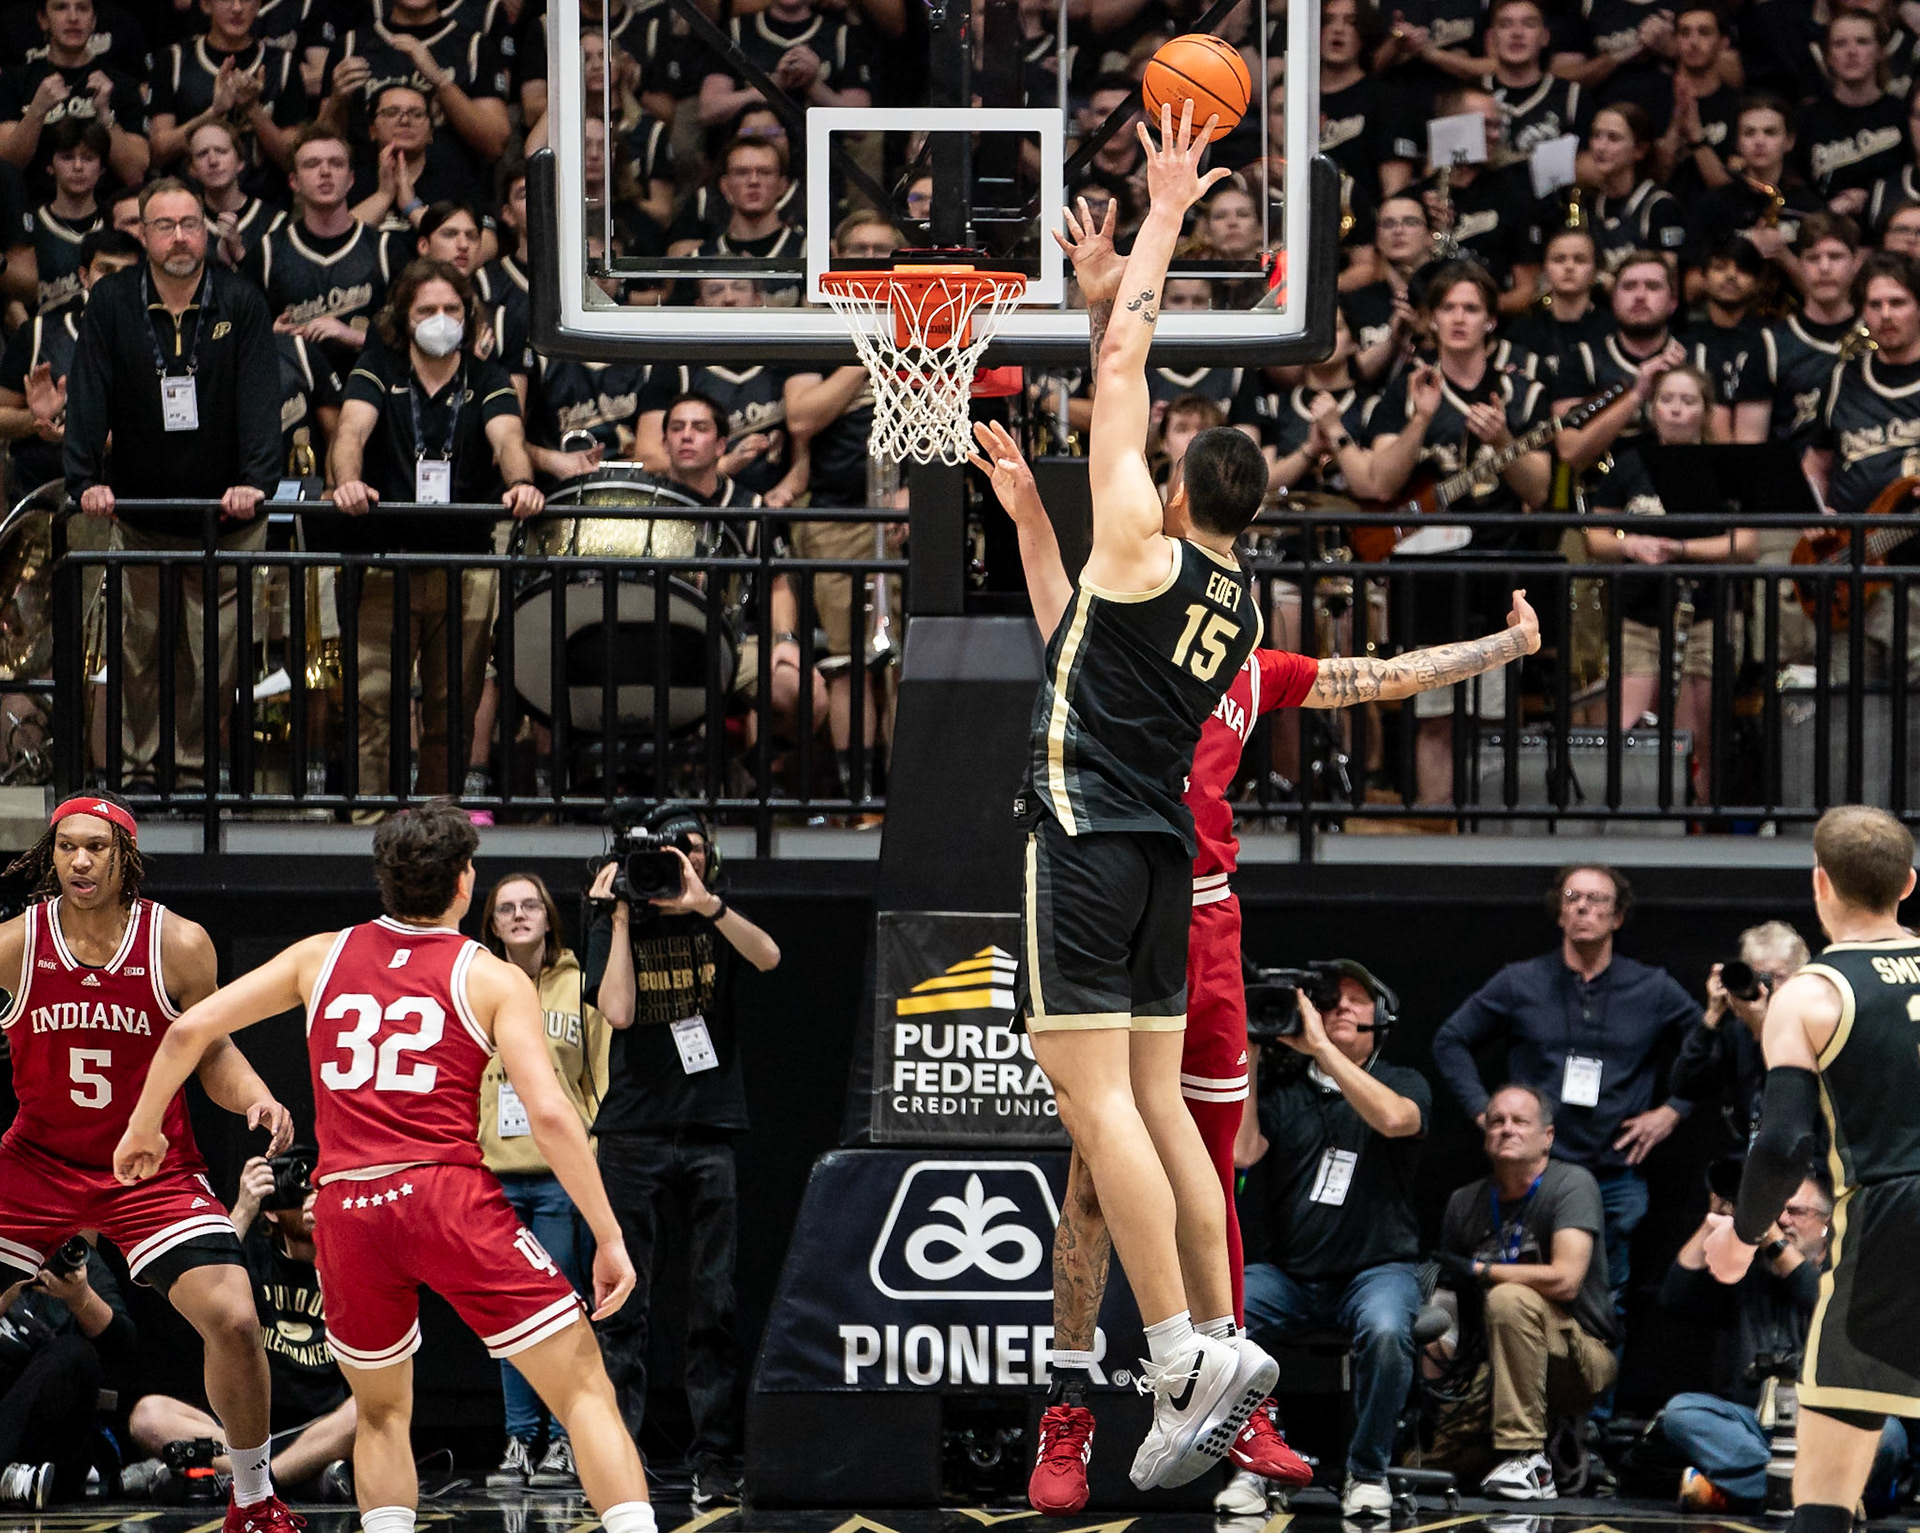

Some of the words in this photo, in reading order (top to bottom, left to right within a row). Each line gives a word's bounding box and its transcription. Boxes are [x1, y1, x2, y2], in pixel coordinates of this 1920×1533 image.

[1206, 571, 1242, 612] EDEY
[1171, 604, 1241, 682] 15
[1212, 693, 1246, 741] NA
[37, 960, 57, 970] RMK
[638, 967, 694, 991] BOILER
[30, 1002, 152, 1037] INDIANA
[320, 993, 446, 1094] 32
[69, 1047, 112, 1109] 5
[893, 1060, 1056, 1096] FEDERA
[892, 1095, 984, 1115] CREDIT
[995, 1098, 1059, 1116] UNIO
